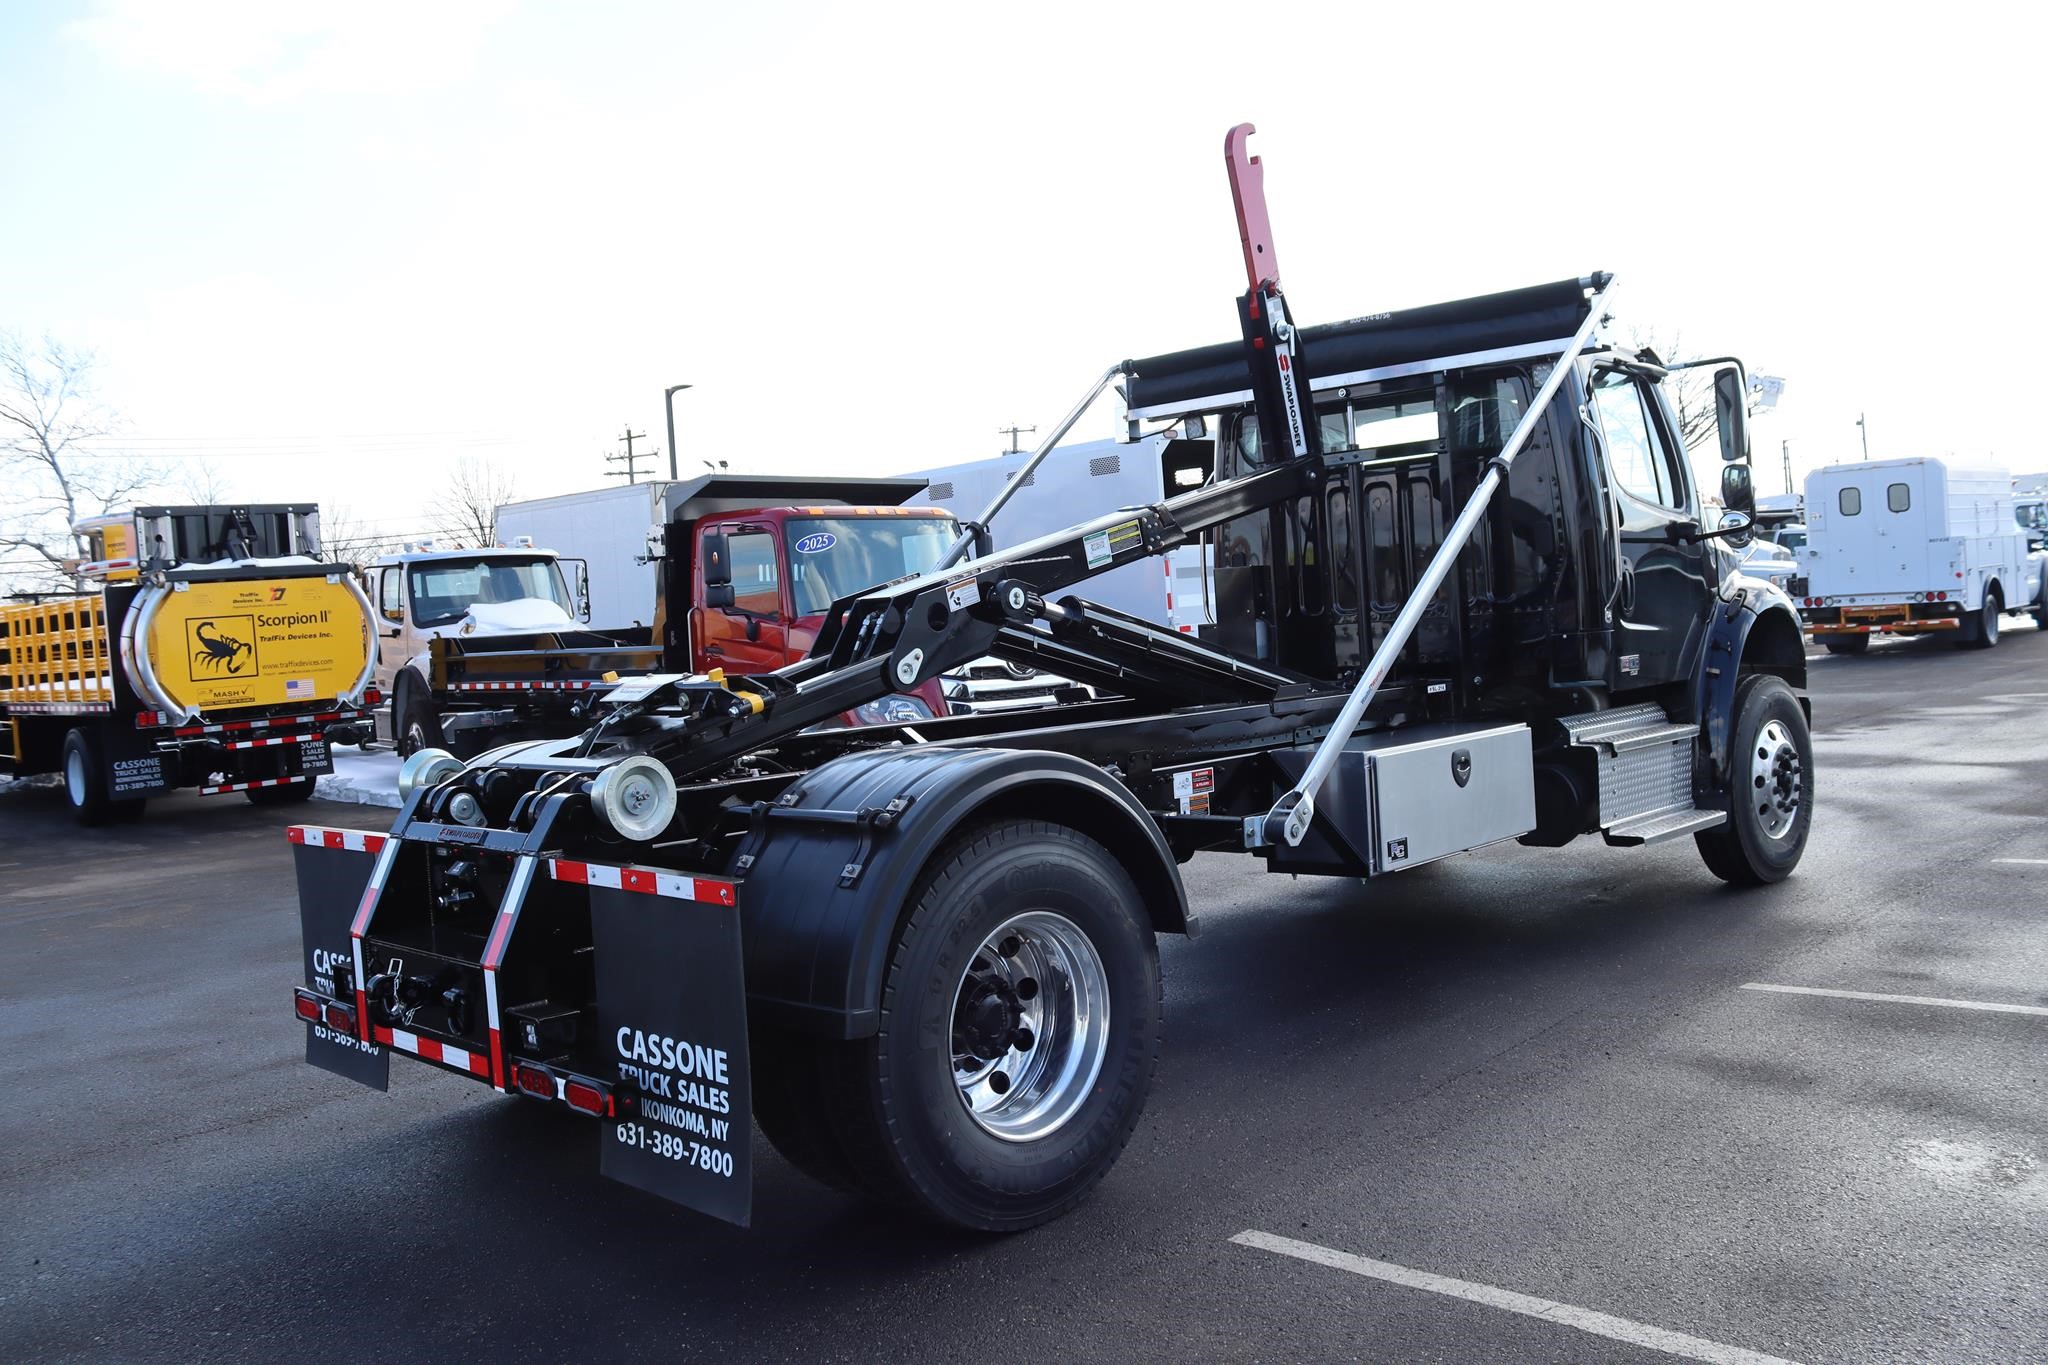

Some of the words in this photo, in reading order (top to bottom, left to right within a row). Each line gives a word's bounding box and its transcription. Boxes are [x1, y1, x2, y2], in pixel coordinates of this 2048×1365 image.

[1283, 374, 1302, 447] SWAPLOADER
[803, 535, 829, 551] 2025
[257, 611, 318, 628] Scorpion
[213, 690, 240, 699] MASH
[113, 758, 161, 771] CASSONE
[115, 769, 139, 777] TRUCK
[140, 766, 161, 775] SALES
[114, 780, 165, 792] 631-389-7800
[616, 1026, 730, 1085] CASSONE
[677, 1079, 730, 1114] SALES
[711, 1118, 730, 1142] NY
[616, 1122, 734, 1178] 631-389-7800
